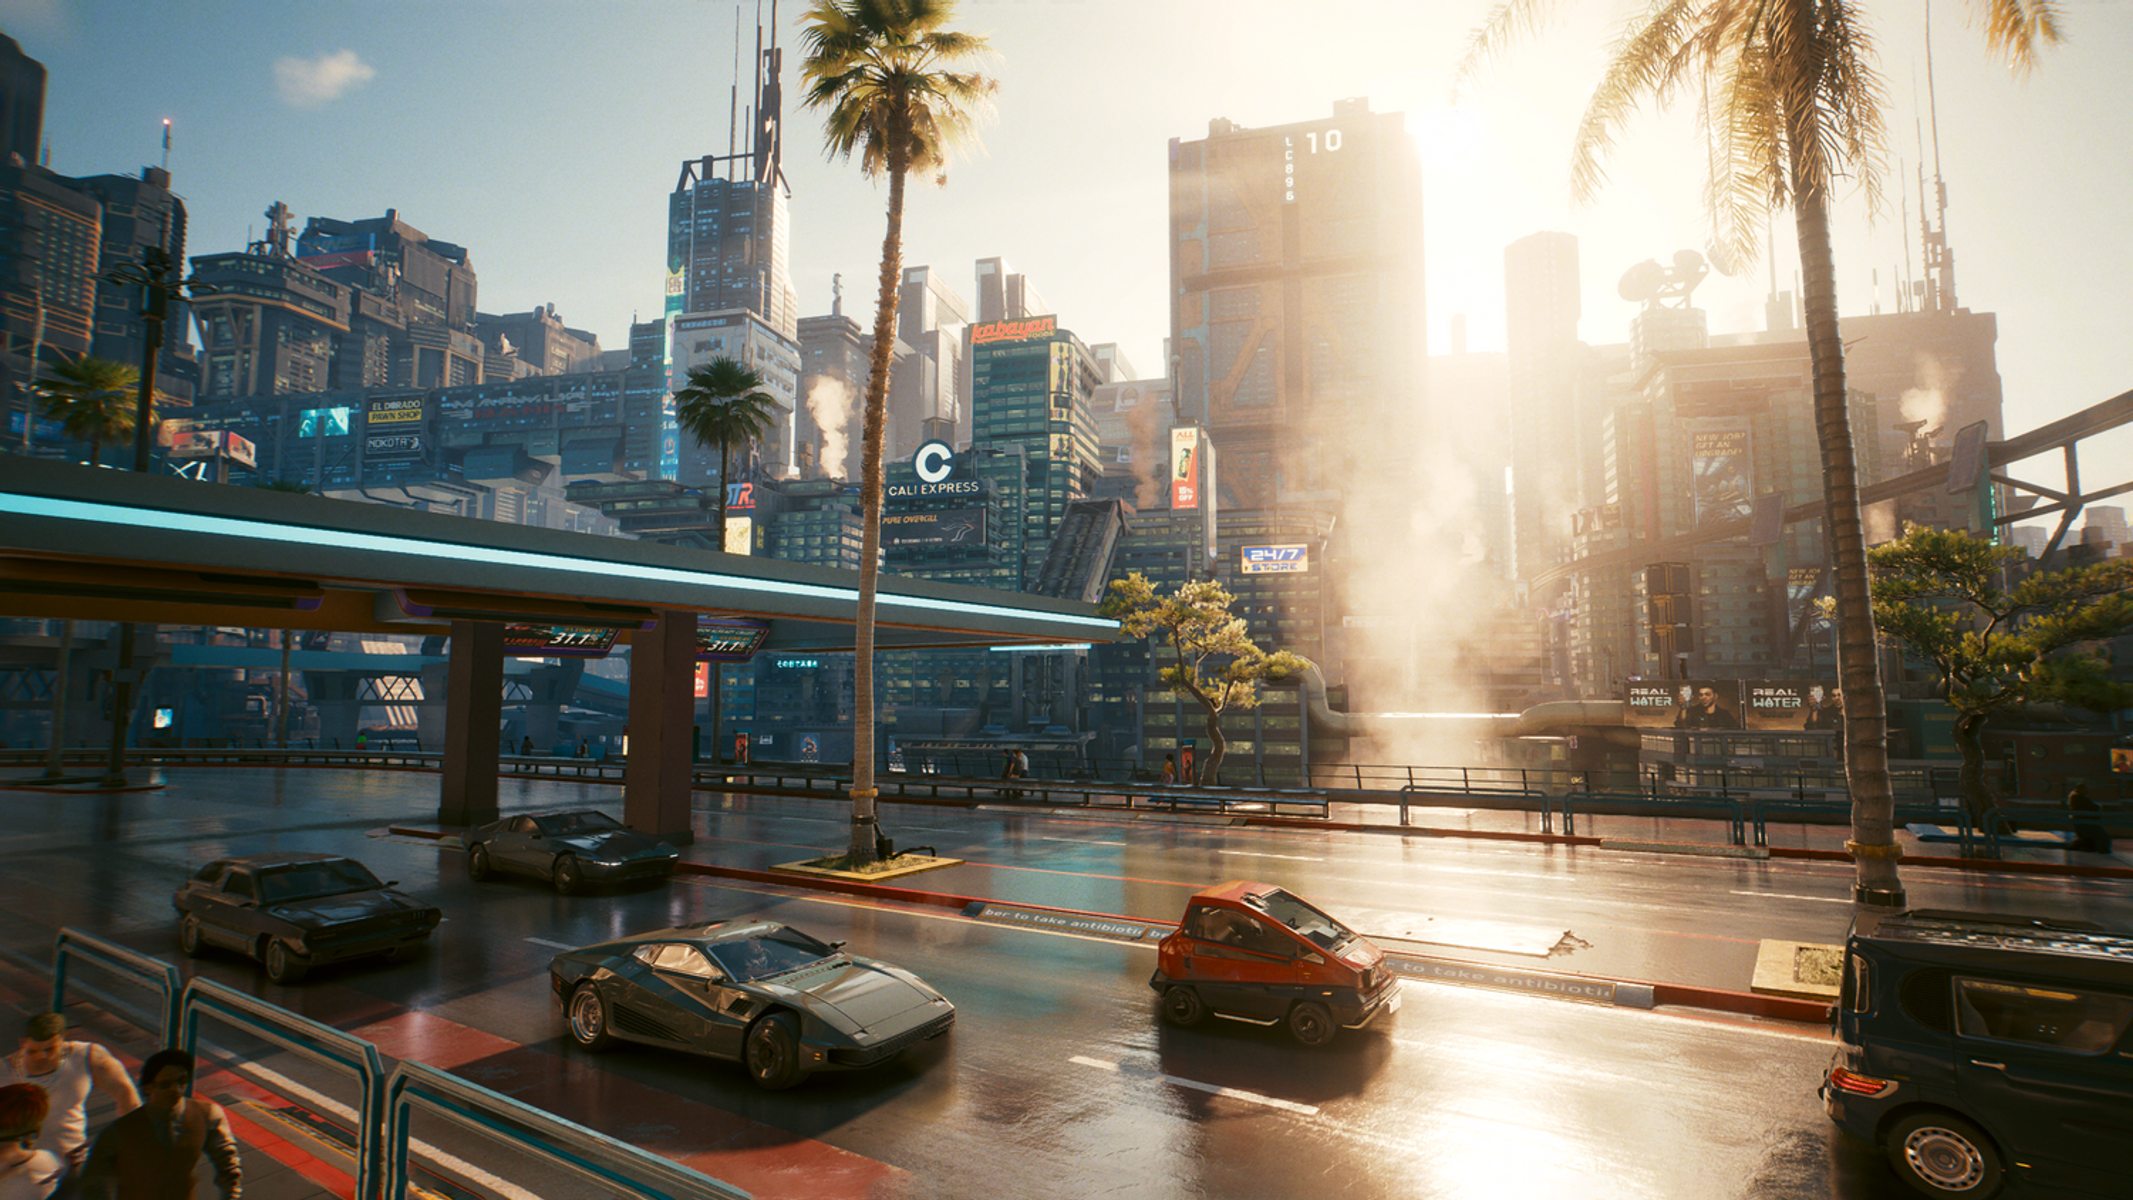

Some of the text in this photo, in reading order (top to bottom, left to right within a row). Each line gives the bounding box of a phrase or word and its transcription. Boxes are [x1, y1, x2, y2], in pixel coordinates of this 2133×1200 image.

[1306, 129, 1342, 154] 10
[970, 318, 1055, 344] kabayan
[372, 400, 421, 411] EL DORADO
[371, 410, 420, 421] PAWN SHOP
[1695, 433, 1719, 441] NEW
[1695, 440, 1731, 449] GET AN
[915, 443, 952, 483] C
[888, 481, 980, 496] CALI EXPRESS
[1178, 494, 1194, 502] OFF
[1250, 549, 1299, 561] 24/7
[1252, 562, 1298, 572] STORE
[1630, 687, 1669, 696] REAL
[1752, 688, 1798, 697] REAL
[1630, 697, 1672, 707] WATER
[1752, 697, 1802, 708] WATER
[984, 908, 1011, 918] ber
[1014, 911, 1029, 921] to
[1033, 914, 1067, 925] take
[1403, 961, 1425, 974] to
[1433, 966, 1485, 981] take
